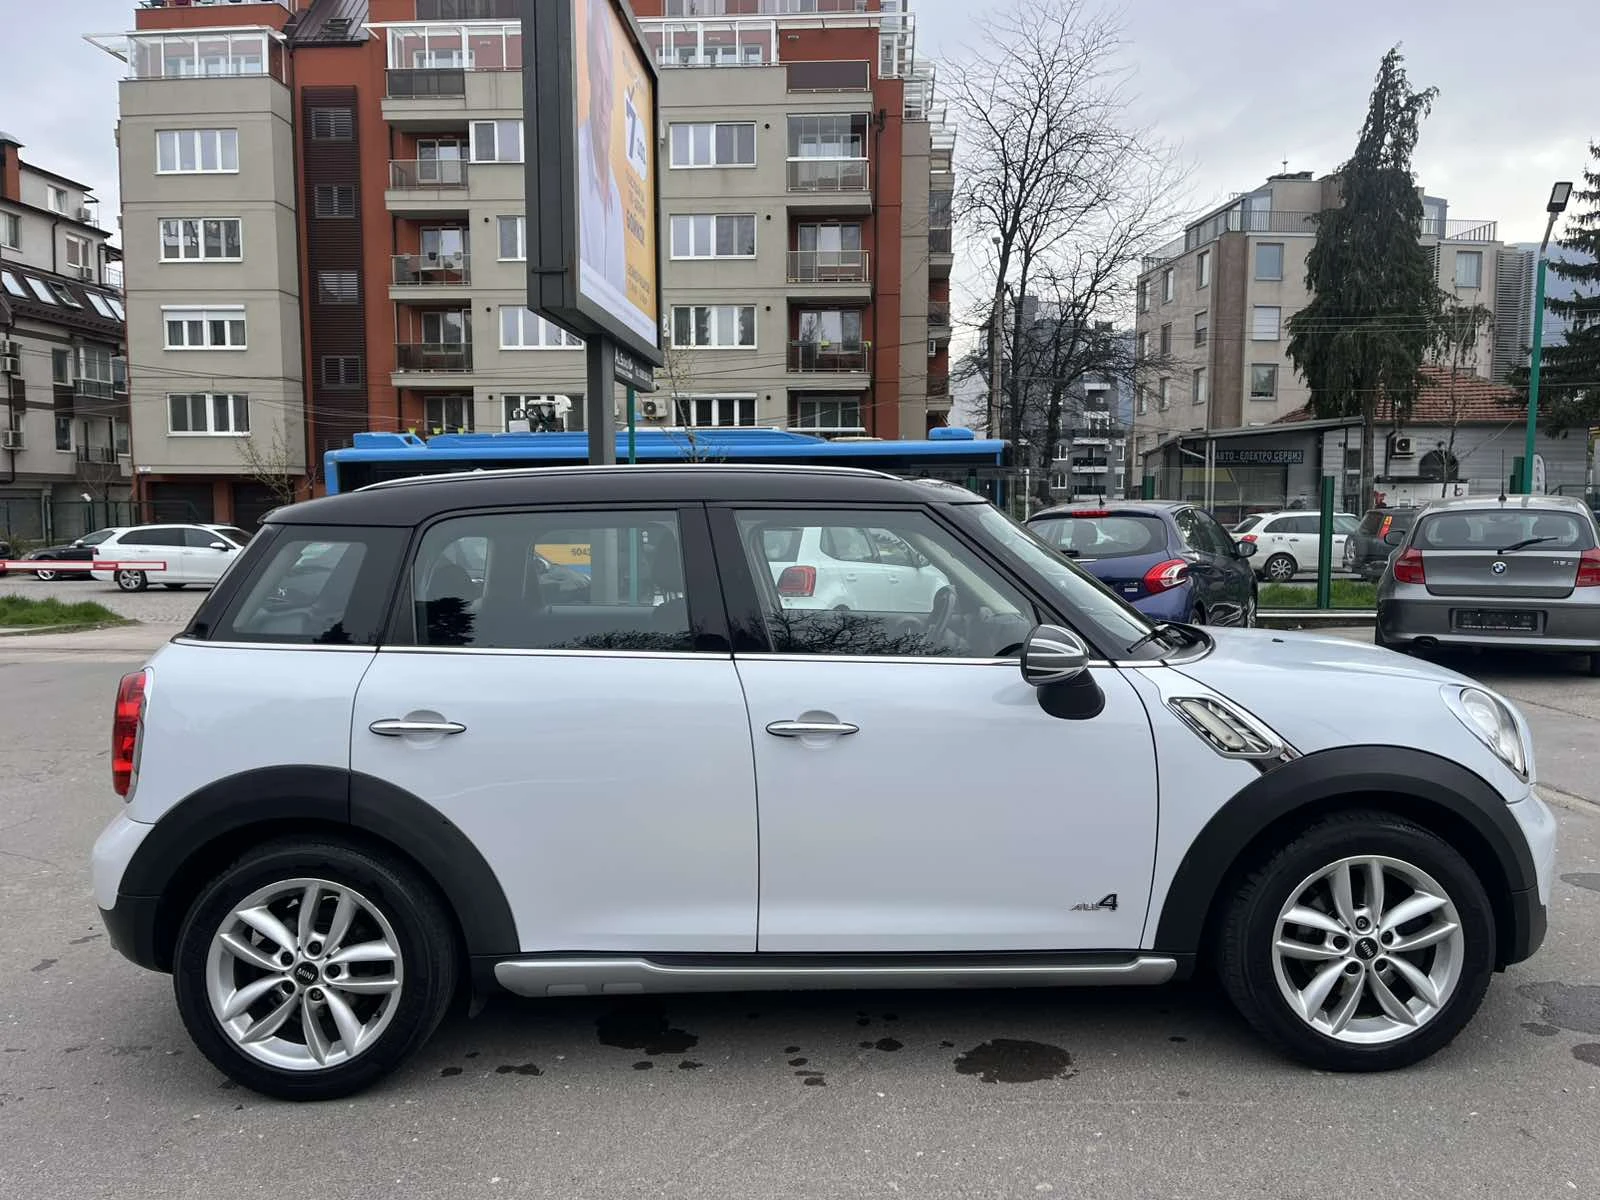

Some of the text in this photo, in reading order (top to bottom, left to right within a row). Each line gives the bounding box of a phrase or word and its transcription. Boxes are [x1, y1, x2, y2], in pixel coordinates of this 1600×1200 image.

[1274, 451, 1302, 460] СЕРВИЗ
[1360, 941, 1374, 956] MINI
[297, 968, 315, 980] MINI
